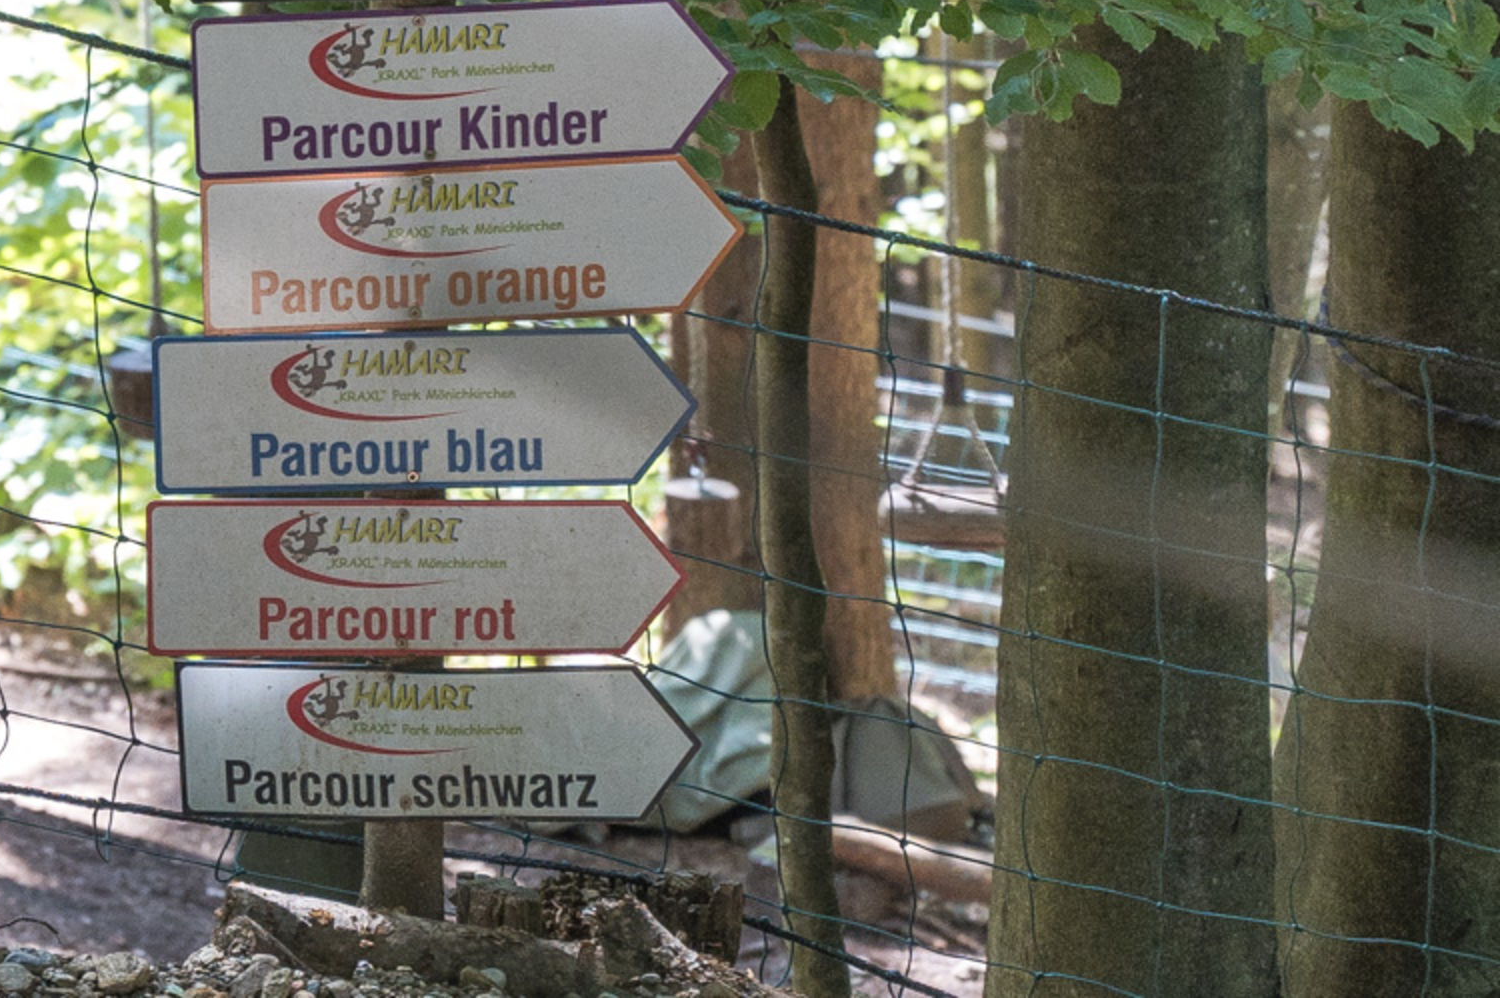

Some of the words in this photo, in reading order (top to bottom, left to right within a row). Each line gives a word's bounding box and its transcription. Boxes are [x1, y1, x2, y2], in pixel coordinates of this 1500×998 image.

[379, 23, 509, 56] HAMARI
[432, 65, 460, 78] Park
[262, 116, 442, 161] Parcour
[459, 101, 608, 151] Kinder
[389, 181, 518, 214] HAMARI
[440, 224, 469, 236] Park
[251, 269, 431, 315] Parcour
[448, 263, 607, 310] orange
[341, 348, 470, 377] HAMARI
[392, 389, 421, 401] Park
[250, 432, 429, 477] Parcour
[447, 429, 543, 474] blau
[333, 516, 462, 544] HAMARI
[382, 557, 412, 568] Park
[258, 597, 437, 641] Parcour
[455, 597, 515, 640] rot
[353, 681, 476, 711] HAMARI
[402, 723, 430, 735] Park
[225, 760, 395, 809] Parcour
[412, 764, 599, 809] schwarz
